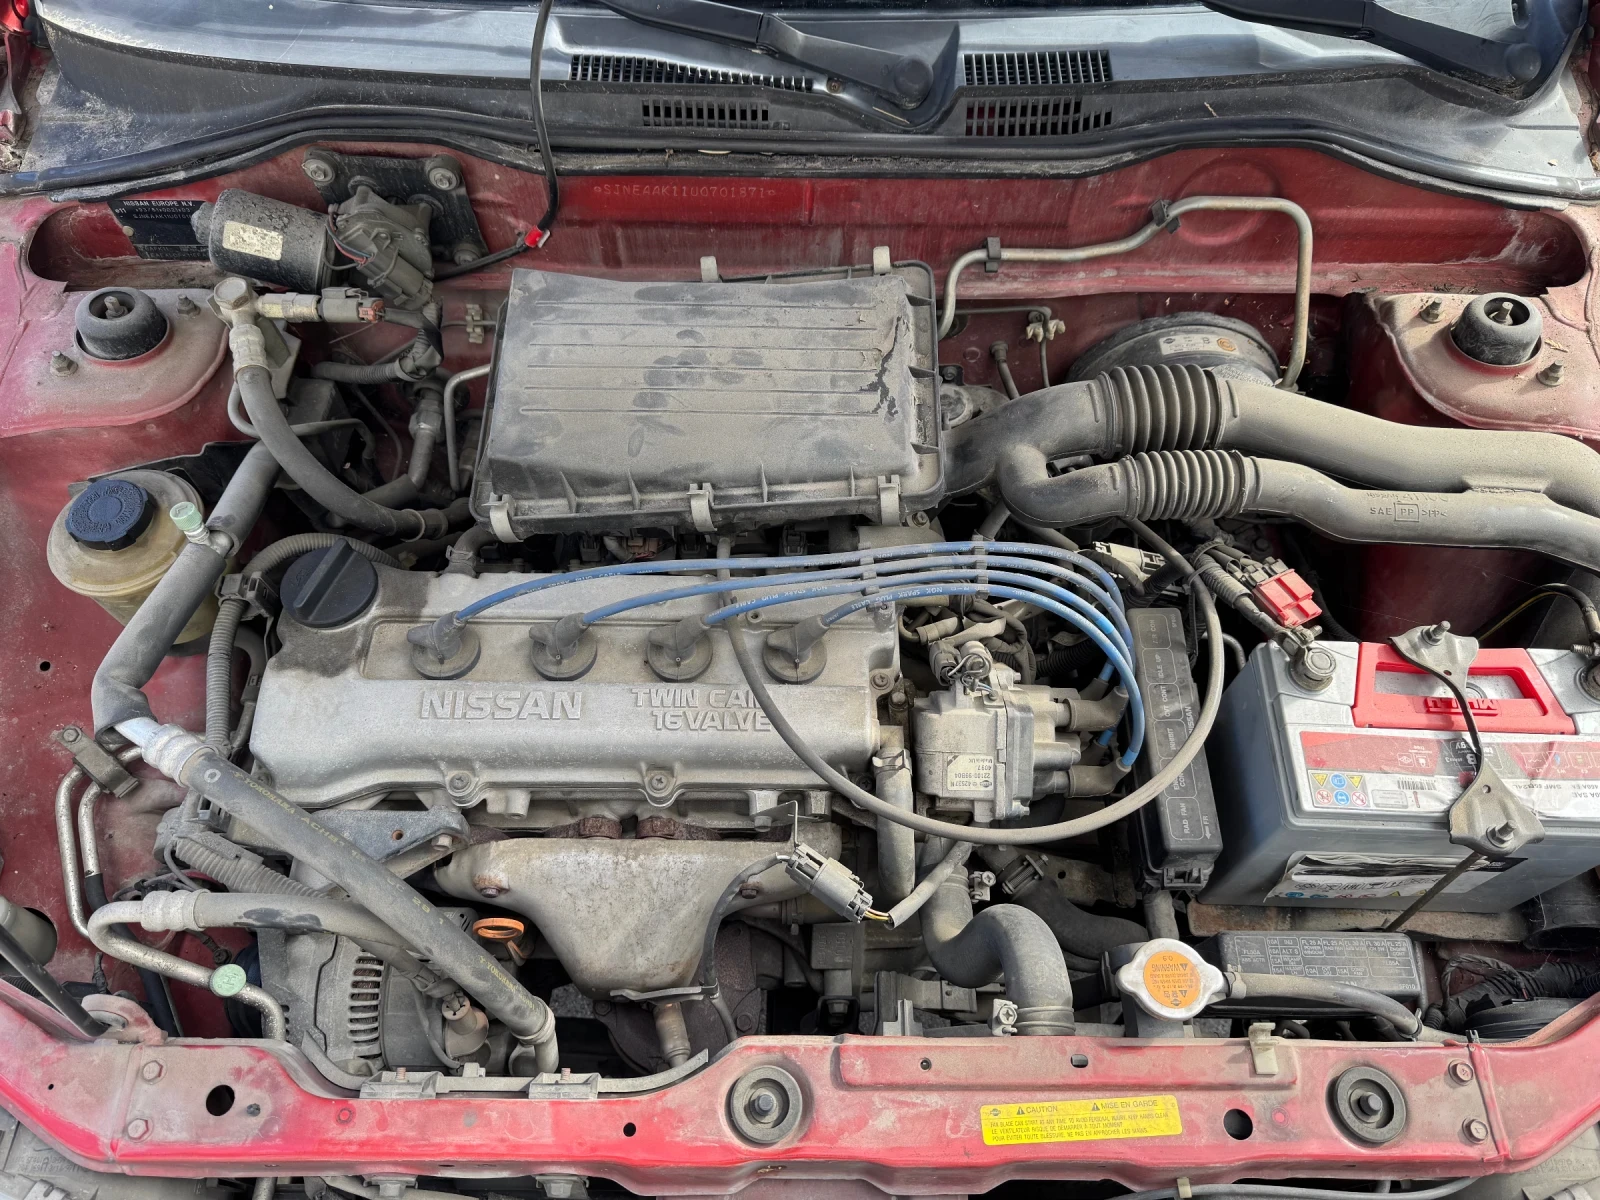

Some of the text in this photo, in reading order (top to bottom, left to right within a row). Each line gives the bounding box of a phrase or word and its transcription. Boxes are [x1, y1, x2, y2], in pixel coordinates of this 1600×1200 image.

[1370, 507, 1393, 516] SAE
[898, 589, 920, 598] SPARK
[875, 594, 893, 603] PLUG
[631, 688, 699, 709] TWIN
[420, 689, 583, 720] NISSAN
[243, 777, 296, 814] YOKOHAMA
[1182, 819, 1190, 834] RAD
[1133, 1099, 1158, 1108] GARDE
[1026, 1105, 1058, 1114] CAUTION
